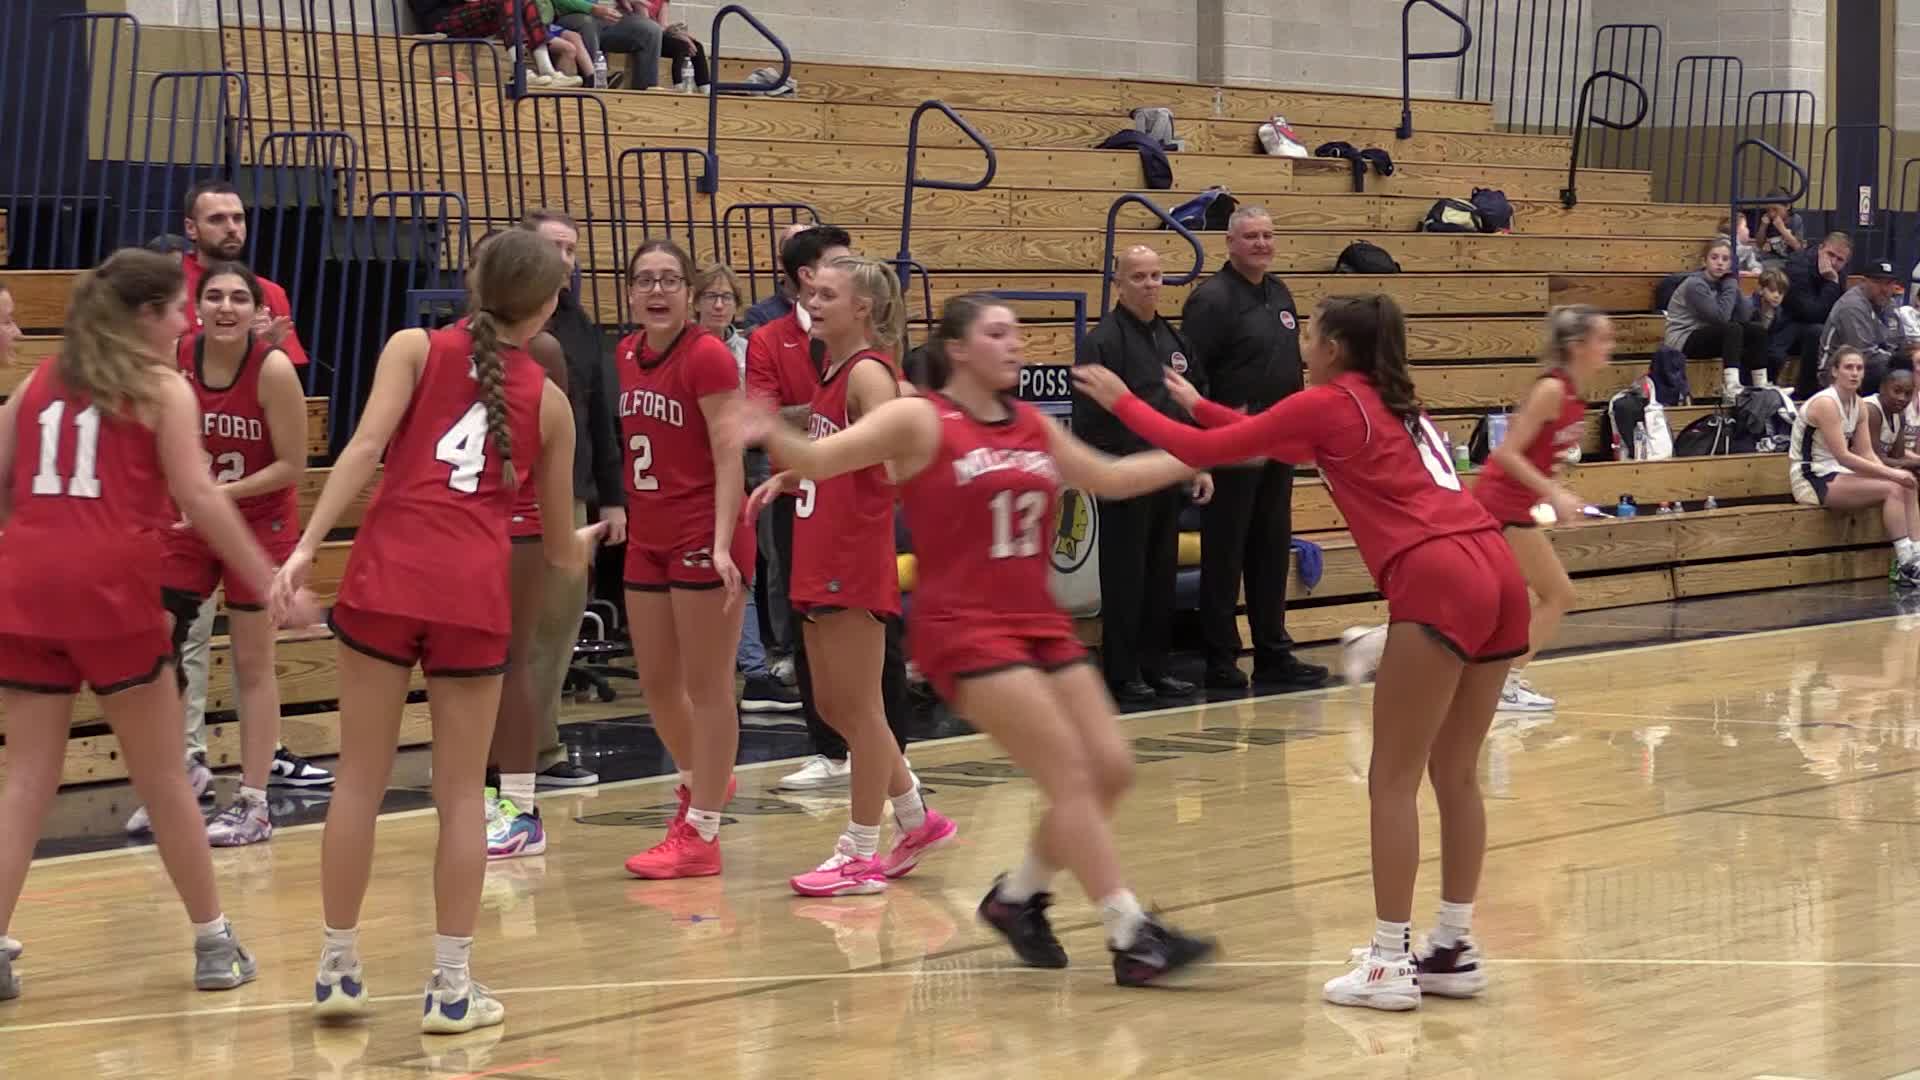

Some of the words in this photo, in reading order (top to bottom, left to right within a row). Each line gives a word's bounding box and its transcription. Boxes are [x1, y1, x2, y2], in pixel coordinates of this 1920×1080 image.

[618, 388, 684, 427] ILFORD
[1018, 367, 1072, 398] POSS.
[31, 399, 102, 499] 11
[203, 411, 263, 441] FORD
[434, 400, 489, 494] 4
[628, 433, 660, 491] 2
[988, 488, 1048, 559] 13
